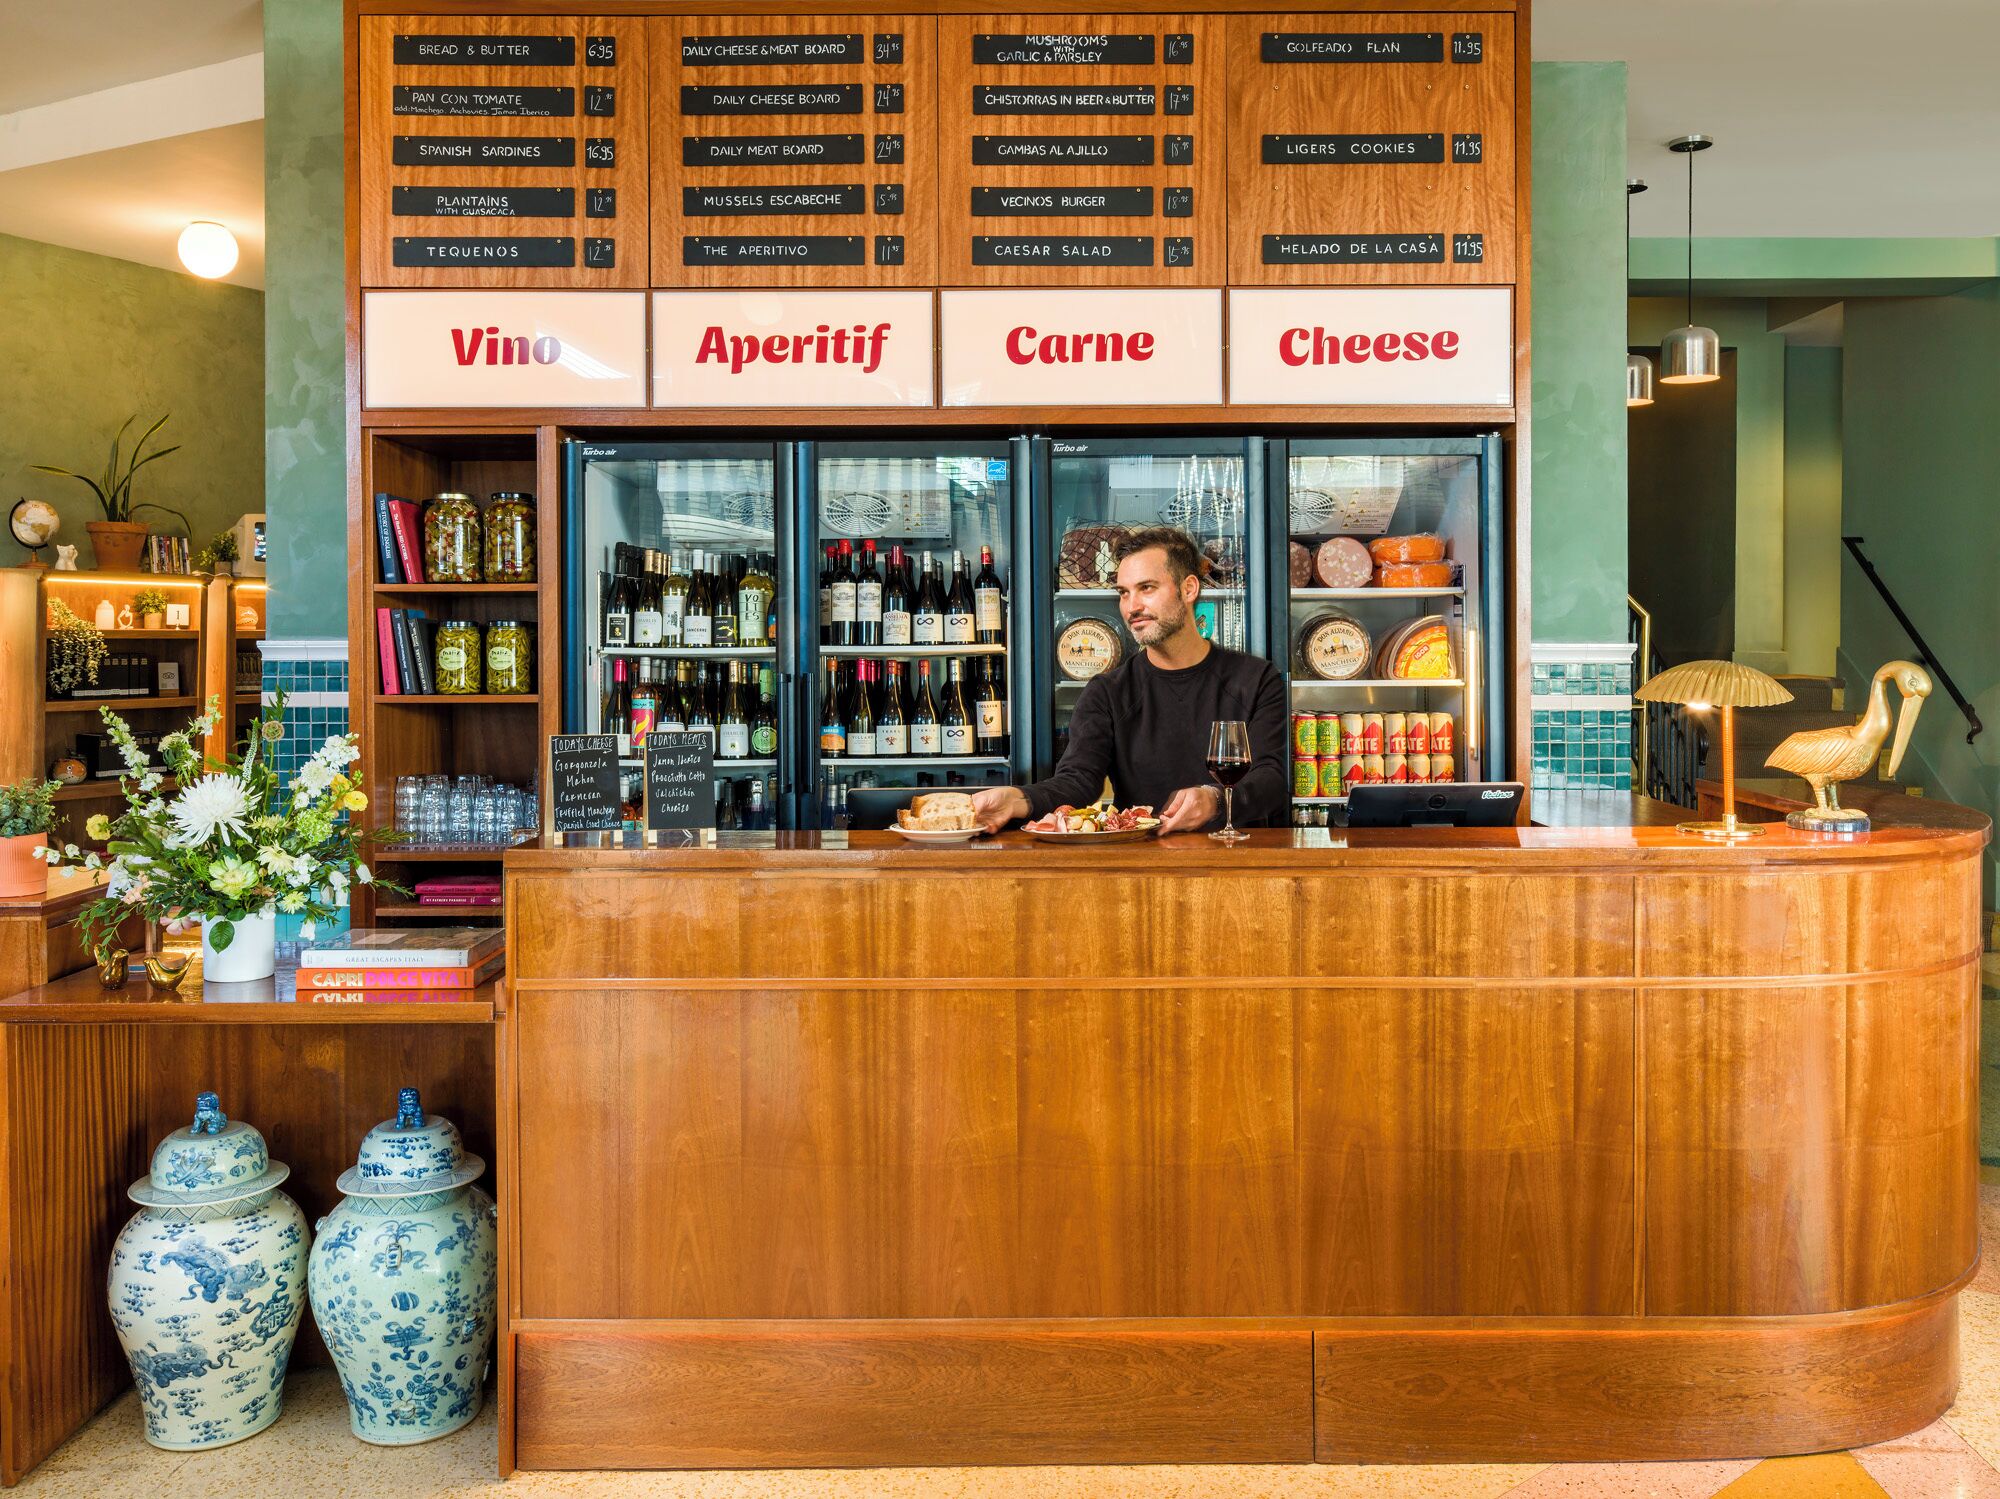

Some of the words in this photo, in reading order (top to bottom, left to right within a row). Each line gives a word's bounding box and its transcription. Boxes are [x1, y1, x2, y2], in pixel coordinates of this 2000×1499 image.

[1026, 36, 1108, 46] MUSHROOMS
[419, 45, 458, 55] BREAD
[467, 45, 475, 55] &
[481, 45, 529, 55] BUTTER
[589, 45, 613, 59] 6.95
[683, 46, 711, 56] DAILY
[715, 45, 758, 55] CHEESE
[805, 44, 845, 54] BOARD
[1287, 42, 1352, 53] GOLFEADO
[1367, 42, 1400, 53] FLAN
[1454, 41, 1481, 55] 11.95
[998, 53, 1040, 62] GARLIC
[1044, 53, 1051, 62] &
[1055, 53, 1102, 63] PARSLEY
[413, 93, 434, 102] PAN
[441, 94, 468, 104] CON
[473, 94, 522, 105] TOMATE
[714, 95, 745, 105] DAILY
[750, 94, 794, 104] CHEESE
[799, 94, 840, 104] BOARD
[985, 95, 1056, 105] CHISTORRAS
[1061, 96, 1071, 105] IN
[1076, 95, 1104, 105] BEER
[1113, 95, 1154, 105] BUTTER
[520, 107, 549, 115] Iberico
[420, 146, 471, 156] SPANISH
[482, 146, 540, 157] SARDINES
[587, 146, 614, 160] 16.95
[711, 146, 743, 156] DAILY
[748, 146, 778, 155] MEAT
[783, 145, 823, 155] BOARD
[999, 145, 1046, 155] GAMBAS
[1050, 145, 1063, 155] AL
[1067, 145, 1107, 155] AJILLO
[1287, 144, 1336, 154] LIGERS
[1351, 143, 1415, 153] COOKIES
[1455, 141, 1480, 155] 11.95
[705, 196, 763, 206] MUSSELS
[771, 195, 841, 205] ESCABECHE
[1001, 197, 1052, 206] VECINOS
[1062, 197, 1105, 206] BURGER
[427, 246, 518, 257] TEQUENOS
[704, 246, 727, 256] THE
[739, 246, 808, 256] APERITIVO
[995, 246, 1050, 256] CAESAR
[1063, 246, 1111, 256] SALAD
[1281, 244, 1340, 254] HELADO
[1351, 244, 1367, 253] DE
[1376, 243, 1392, 253] LA
[1399, 242, 1438, 253] CASA
[1455, 241, 1483, 256] 11.95
[451, 327, 561, 366] Vino
[695, 323, 891, 374] Aperitif
[1006, 326, 1154, 365] Carne
[1279, 327, 1460, 367] Cheese
[1053, 444, 1075, 452] Turbo
[1076, 444, 1088, 452] air
[745, 594, 759, 602] VO
[1068, 631, 1079, 640] DON
[1081, 630, 1104, 641] ALVARO
[1317, 630, 1330, 642] DON
[1330, 628, 1353, 637] ALVARO
[1414, 647, 1429, 659] IGOR
[1321, 657, 1360, 668] MANCHEGO
[588, 737, 613, 749] CHEESE
[647, 733, 677, 747] TODAYS
[682, 733, 707, 745] MEATS
[653, 755, 675, 767] Jamon
[677, 754, 700, 765] Iberico
[555, 760, 607, 774] Gorgonzola
[662, 804, 689, 813] Chorizo
[312, 973, 363, 987] CAPRI
[366, 972, 417, 986] DOLCE
[421, 972, 460, 986] VITA
